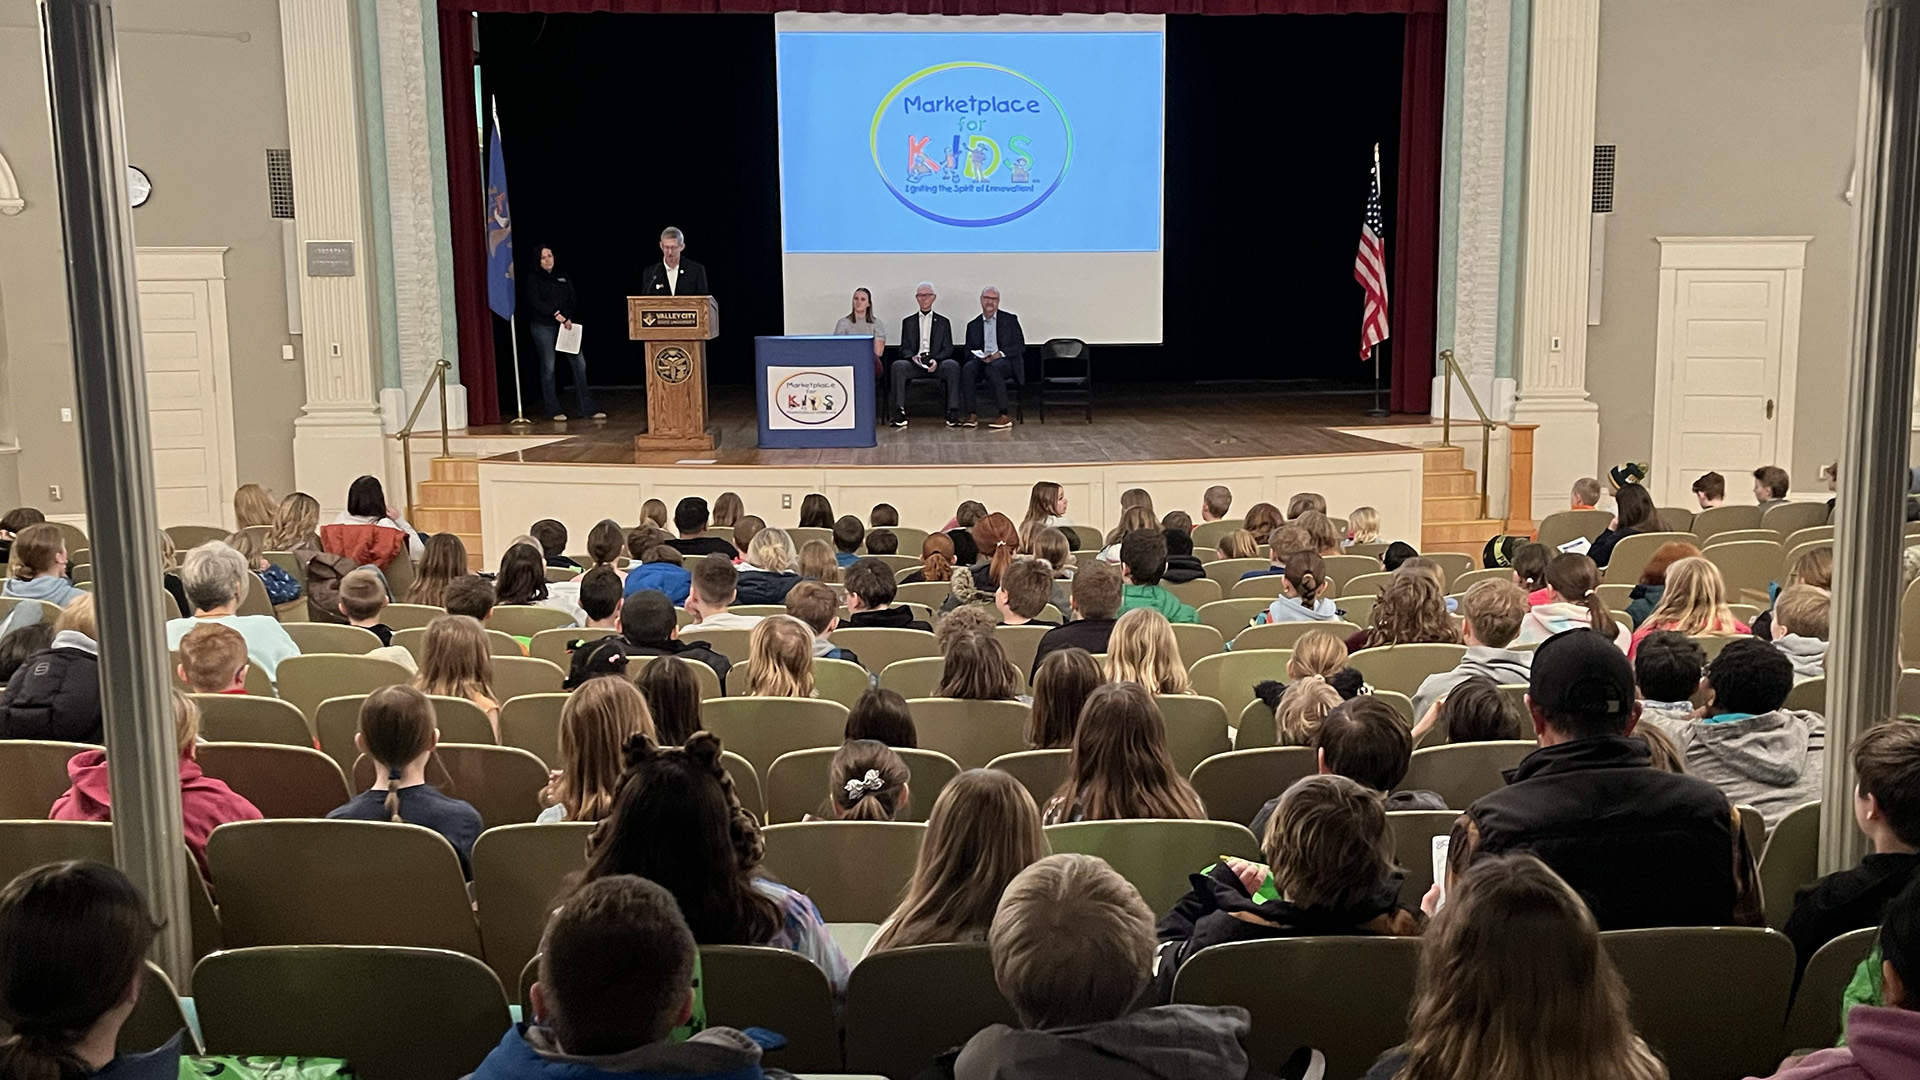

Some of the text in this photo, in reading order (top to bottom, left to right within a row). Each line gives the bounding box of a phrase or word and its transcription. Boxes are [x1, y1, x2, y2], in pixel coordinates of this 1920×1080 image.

[904, 95, 1040, 115] Marketplace
[958, 117, 987, 131] for
[908, 134, 1034, 180] KIDS
[905, 185, 937, 194] Igniting
[939, 184, 952, 193] the
[954, 184, 974, 194] Spirit
[976, 184, 985, 193] of
[788, 395, 834, 411] KIDS
